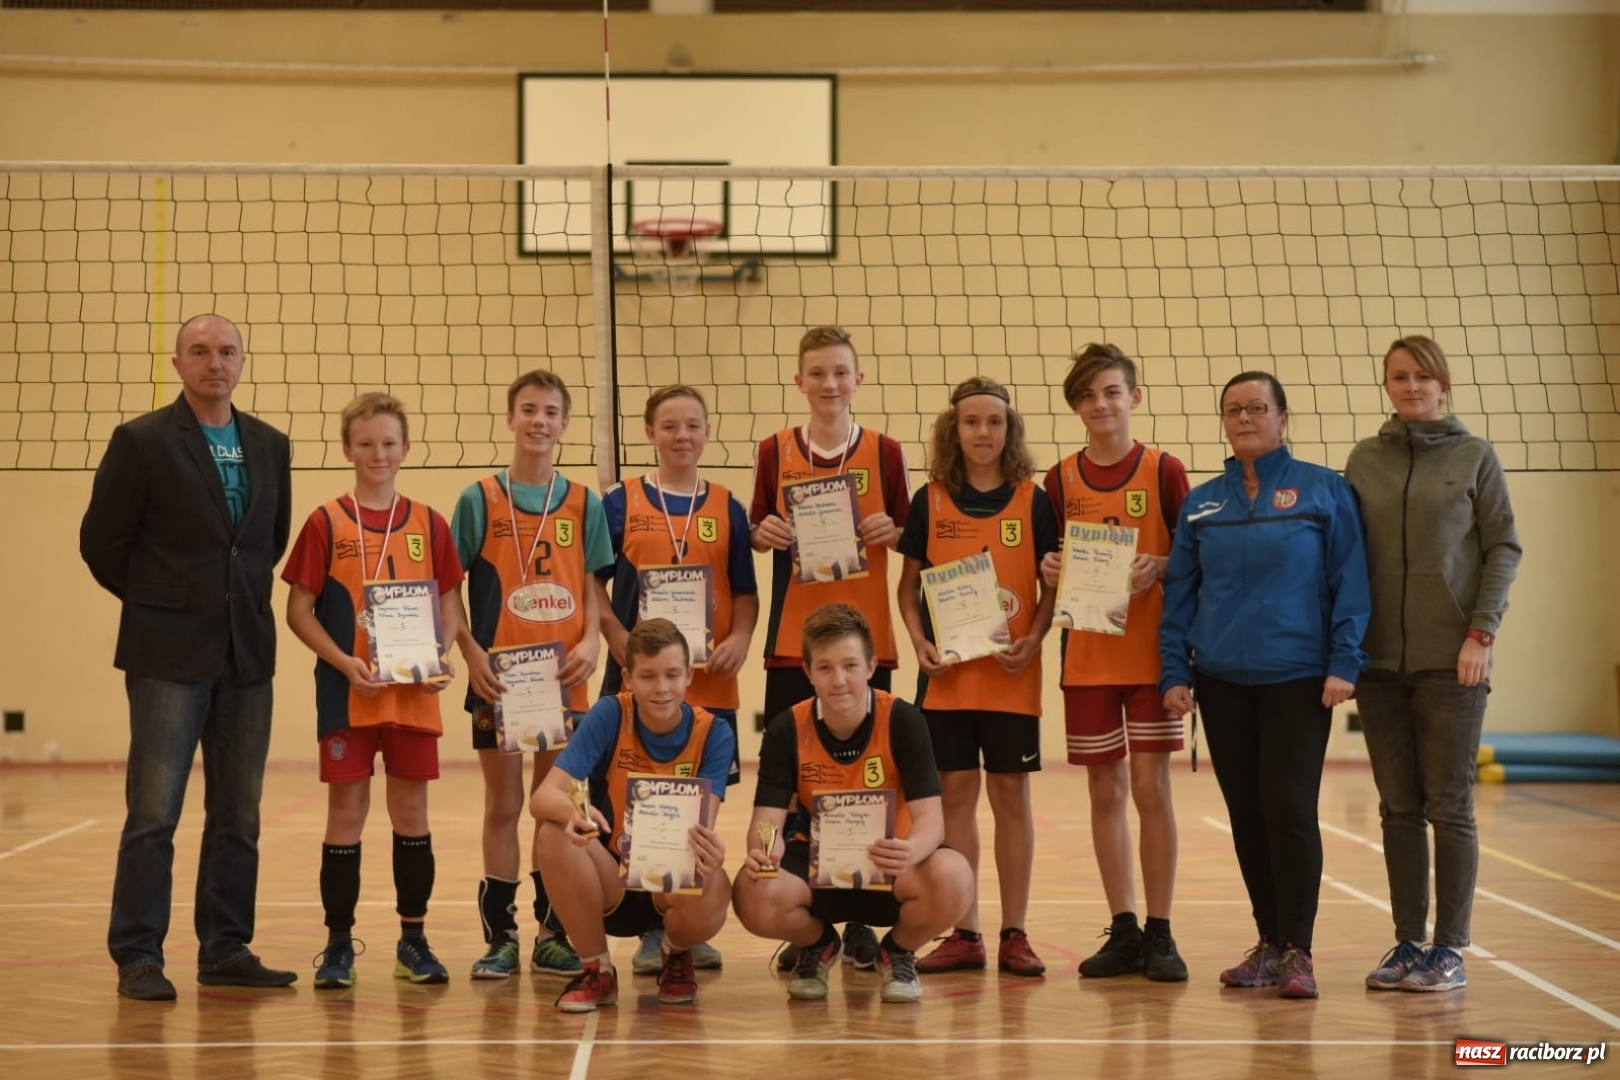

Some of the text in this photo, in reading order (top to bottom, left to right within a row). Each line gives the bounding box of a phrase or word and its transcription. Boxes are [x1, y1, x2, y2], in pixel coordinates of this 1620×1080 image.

[1130, 499, 1142, 513] 3
[702, 524, 713, 537] 3
[1005, 527, 1017, 542] 3
[535, 540, 552, 576] 2
[867, 766, 880, 783] 3
